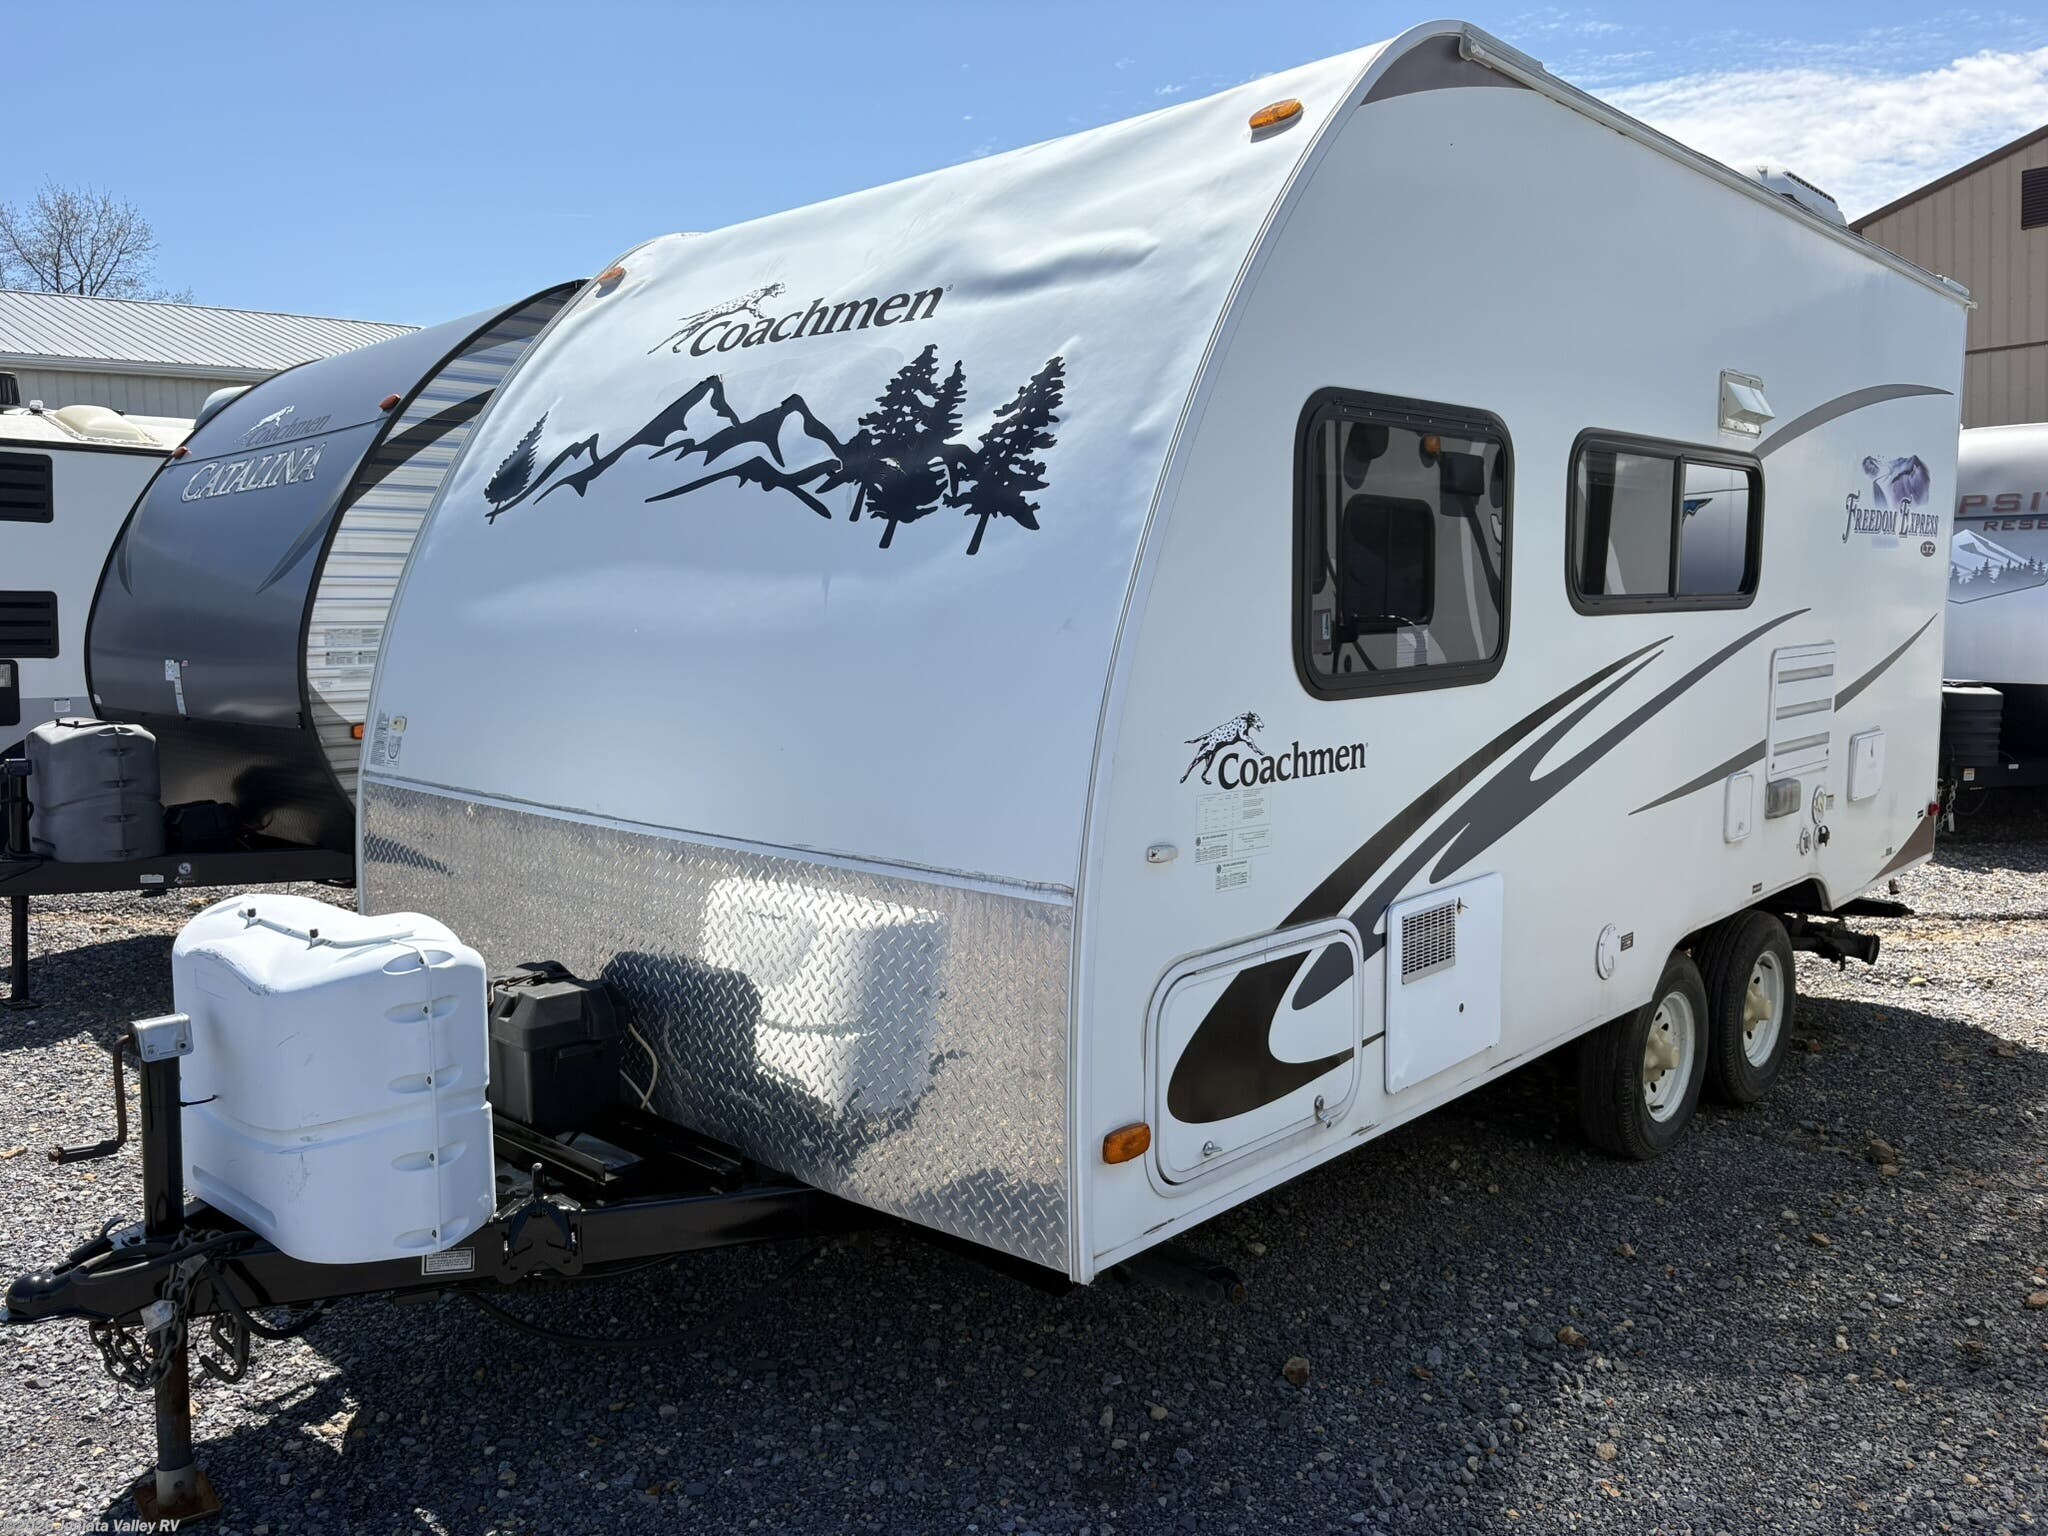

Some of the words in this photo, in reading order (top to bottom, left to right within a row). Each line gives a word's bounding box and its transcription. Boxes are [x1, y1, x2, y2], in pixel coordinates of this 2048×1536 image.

[689, 286, 944, 357] Coachmen
[181, 442, 327, 502] CATALINA
[1842, 491, 1897, 543] FREEDOM
[1899, 497, 1939, 538] EXPRESS
[1958, 491, 2048, 514] PSI
[1218, 741, 1366, 790] Coachmen
